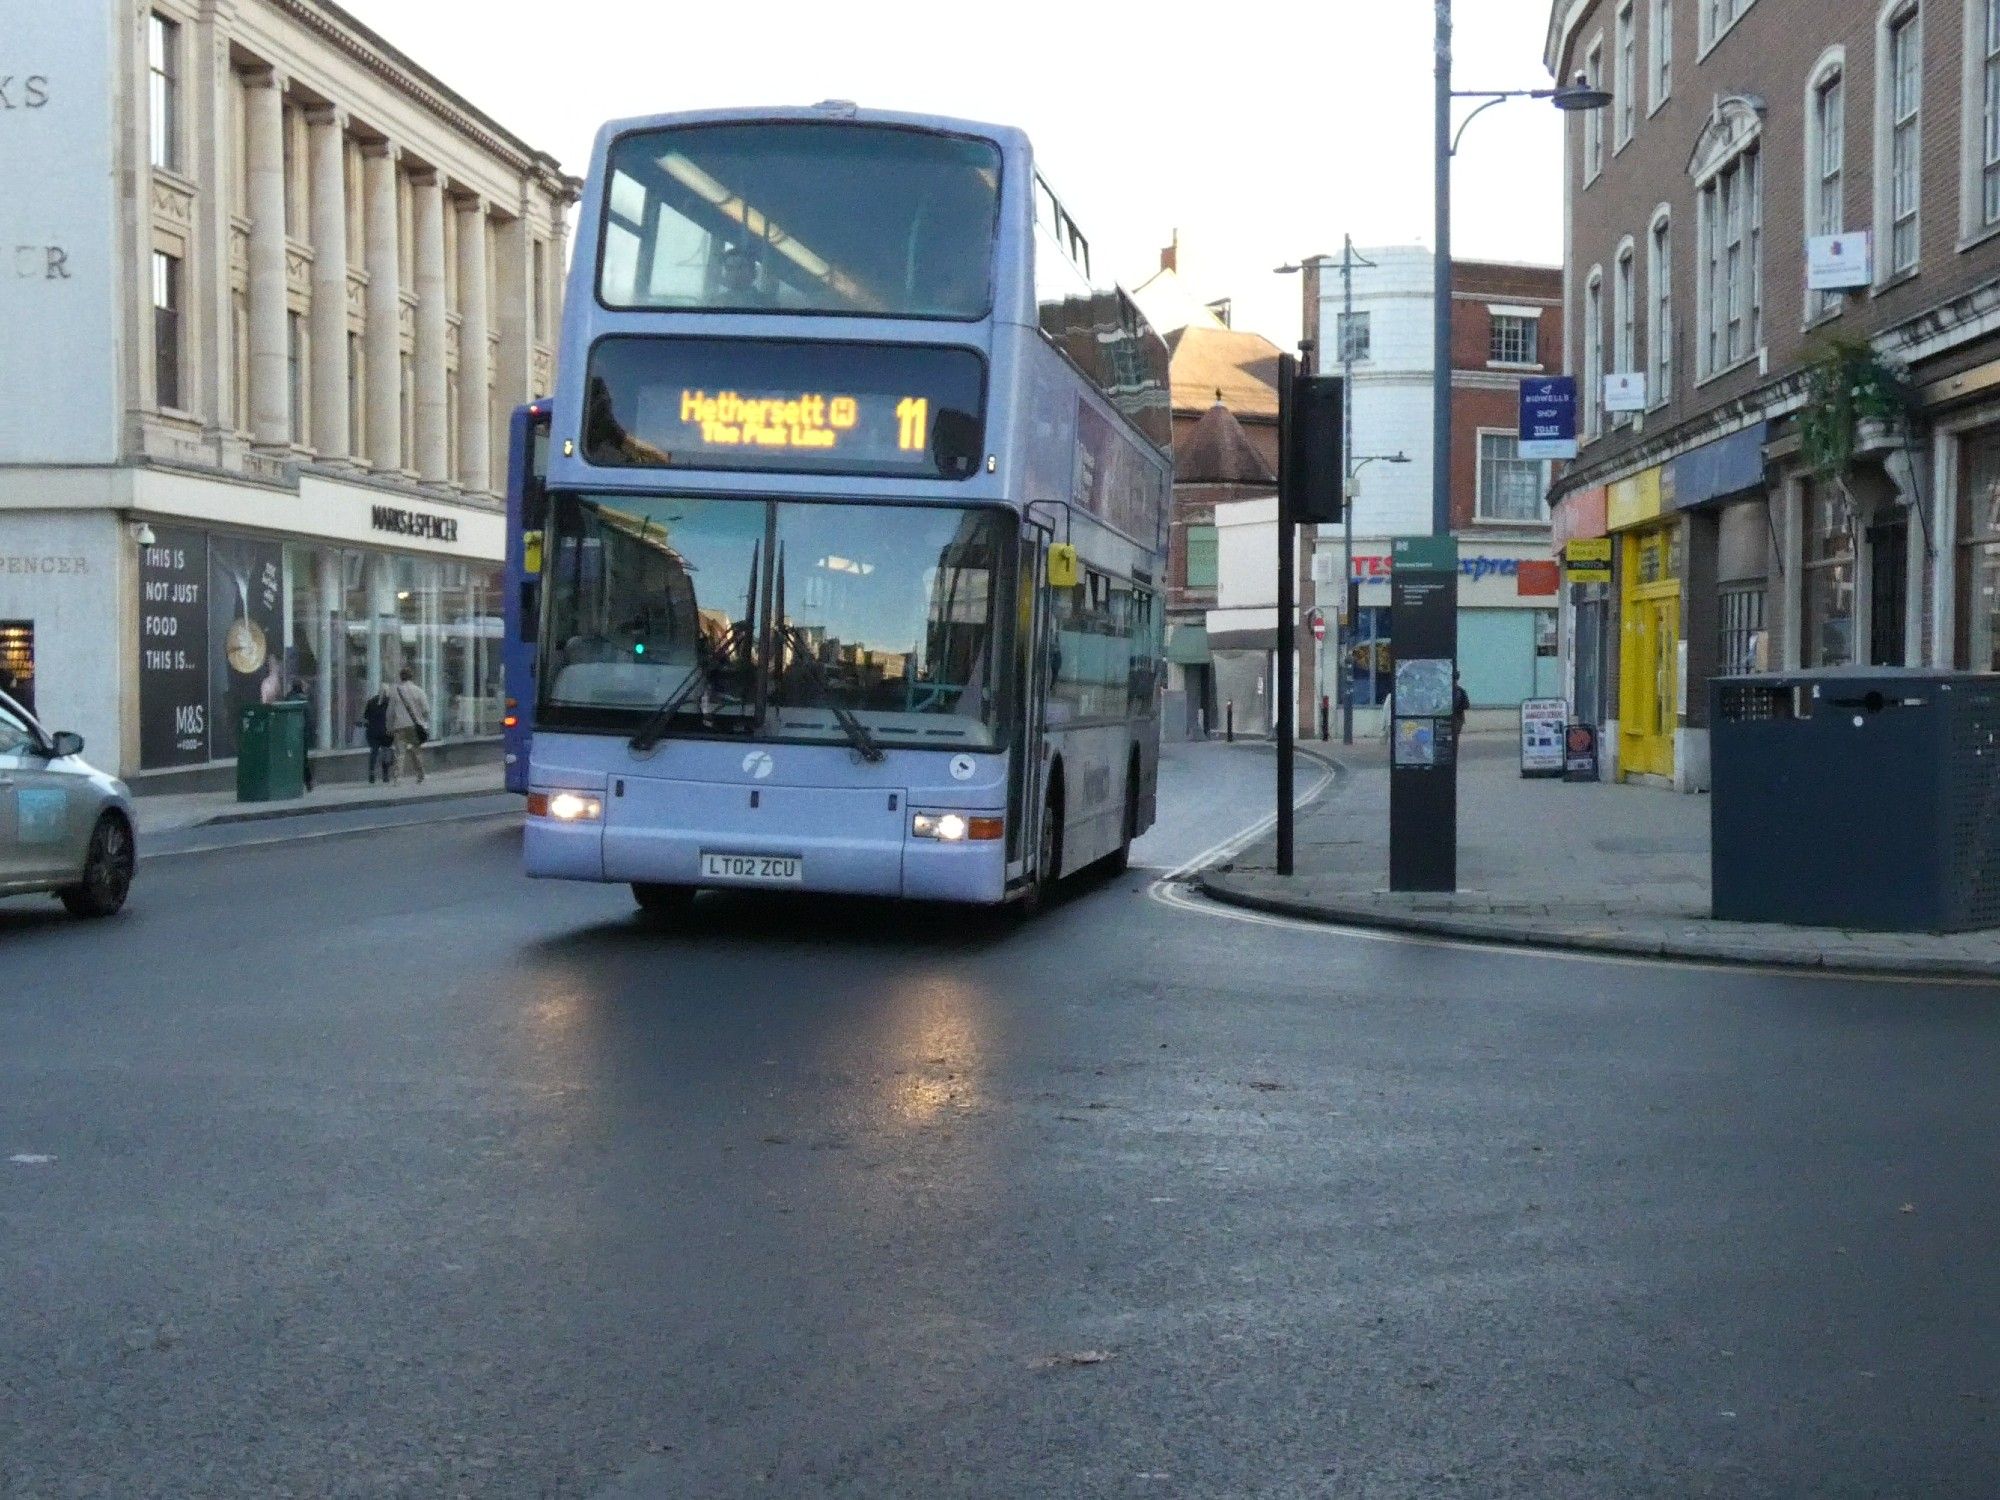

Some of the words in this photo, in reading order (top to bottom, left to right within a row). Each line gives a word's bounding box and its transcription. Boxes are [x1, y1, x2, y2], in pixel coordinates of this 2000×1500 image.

[681, 390, 825, 426] Hethersett
[897, 397, 927, 450] 11
[146, 548, 171, 569] THIS
[174, 549, 185, 570] IS
[146, 581, 169, 601] NOT
[172, 584, 199, 604] JUST
[146, 615, 178, 637] FOOD
[146, 649, 172, 671] THIS
[176, 705, 203, 734] M&S
[709, 858, 755, 876] LT02
[761, 860, 795, 877] ZCU
